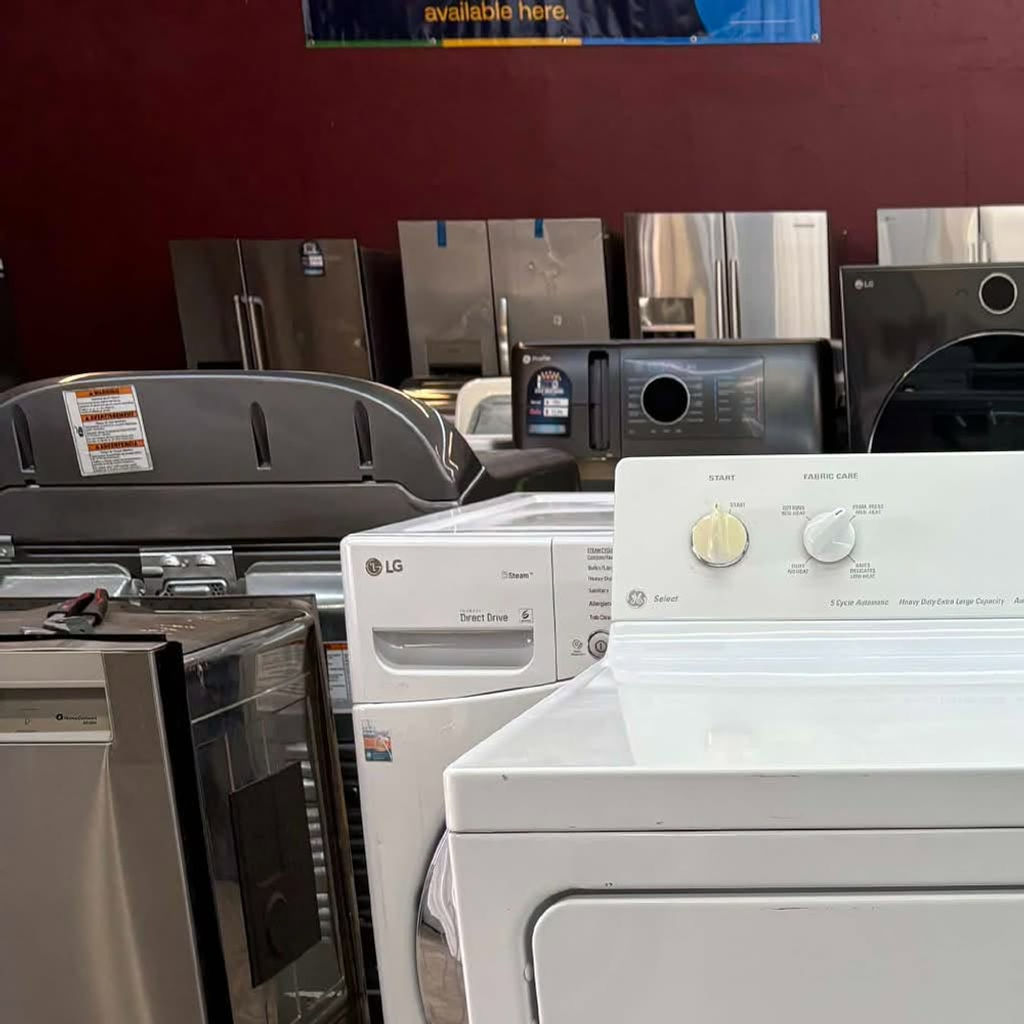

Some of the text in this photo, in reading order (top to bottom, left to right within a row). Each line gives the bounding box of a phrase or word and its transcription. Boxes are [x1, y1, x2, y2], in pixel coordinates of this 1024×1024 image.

[424, 0, 570, 22] available here.
[864, 280, 874, 289] LG
[708, 474, 736, 482] START
[803, 472, 859, 481] FABRIC CARE
[385, 559, 404, 574] LG
[654, 594, 678, 603] Select
[899, 598, 919, 607] Heavy
[920, 598, 936, 606] Duty
[956, 597, 974, 606] Large
[975, 597, 1004, 606] Capacity
[460, 613, 509, 622] Direct Drive
